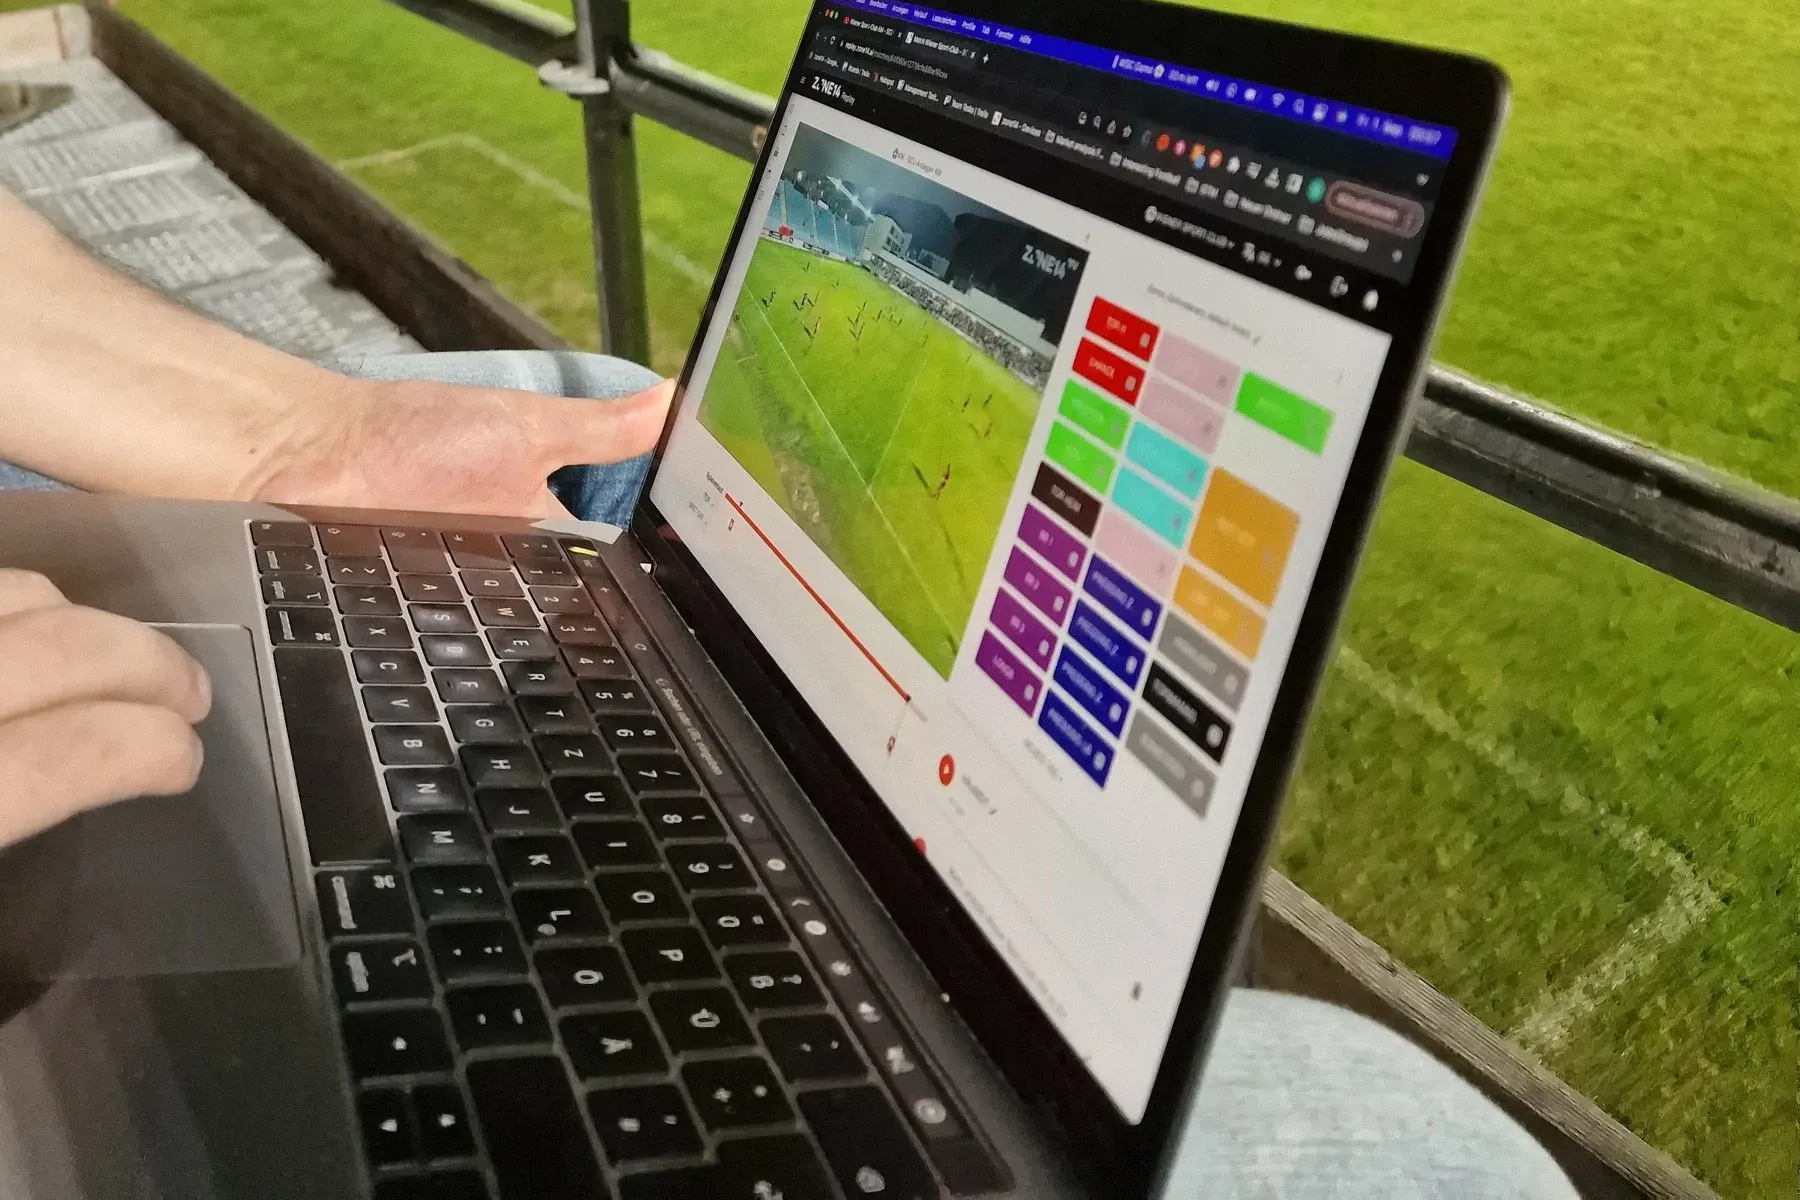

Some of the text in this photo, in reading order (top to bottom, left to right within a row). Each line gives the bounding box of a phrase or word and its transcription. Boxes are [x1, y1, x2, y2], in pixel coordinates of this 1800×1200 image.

[498, 608, 514, 616] W
[432, 613, 450, 621] S
[446, 645, 464, 655] D
[391, 699, 410, 707] V
[475, 719, 494, 727] G
[403, 740, 422, 748] B
[564, 749, 583, 757] Z
[491, 760, 511, 769] H
[415, 781, 438, 797] N
[585, 792, 605, 802] U
[509, 806, 529, 814] J
[663, 814, 682, 823] 8
[432, 831, 454, 843] M
[528, 855, 551, 865] K
[689, 863, 709, 873] 9
[550, 910, 571, 921] L
[660, 949, 683, 961] P
